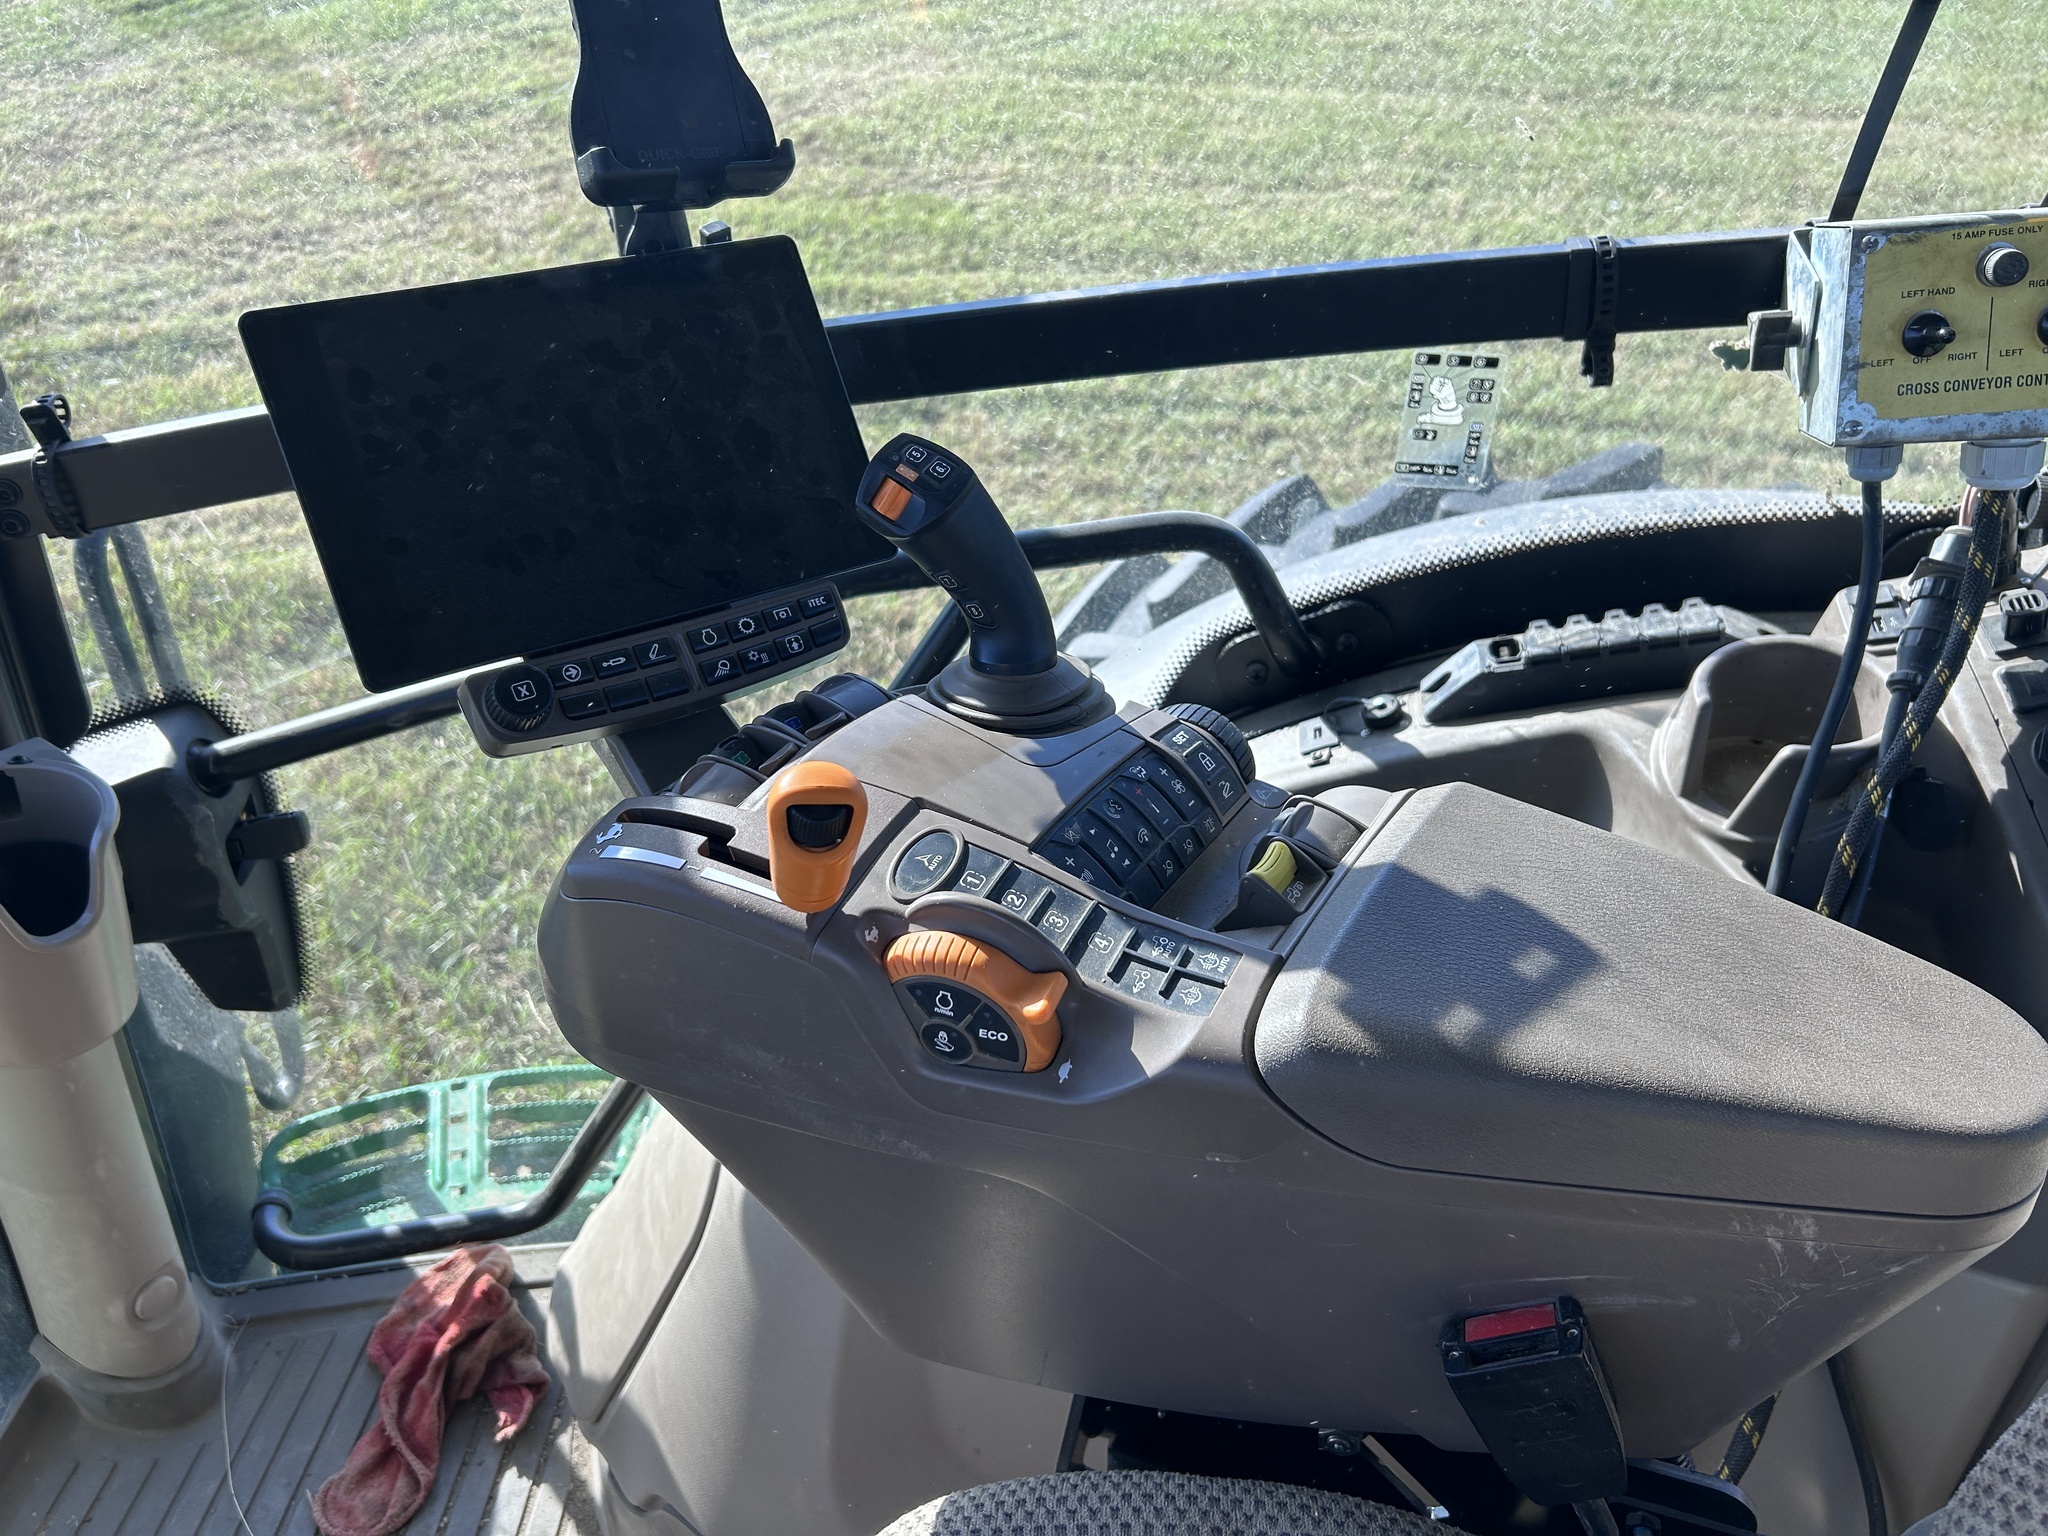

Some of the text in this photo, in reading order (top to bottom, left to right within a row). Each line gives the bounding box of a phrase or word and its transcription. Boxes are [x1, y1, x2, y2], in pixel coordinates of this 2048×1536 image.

[1952, 225, 2044, 240] 15 AMP FUSE ONLY
[1901, 286, 1956, 299] LEFT HAND
[1999, 347, 2024, 357] LEFT
[1870, 351, 1978, 368] LEFT OFF RIGHT
[1897, 381, 1940, 397] CROSS
[1943, 376, 2012, 393] CONVEYOR
[1171, 730, 1190, 745] SET
[928, 854, 943, 871] AUTO
[1006, 894, 1023, 906] 2
[1049, 915, 1064, 928] 3
[1094, 937, 1109, 949] 4
[1162, 941, 1176, 959] AUTO
[1217, 956, 1231, 974] AUTO
[934, 1006, 954, 1017] n/min
[978, 1028, 1009, 1042] ECO
